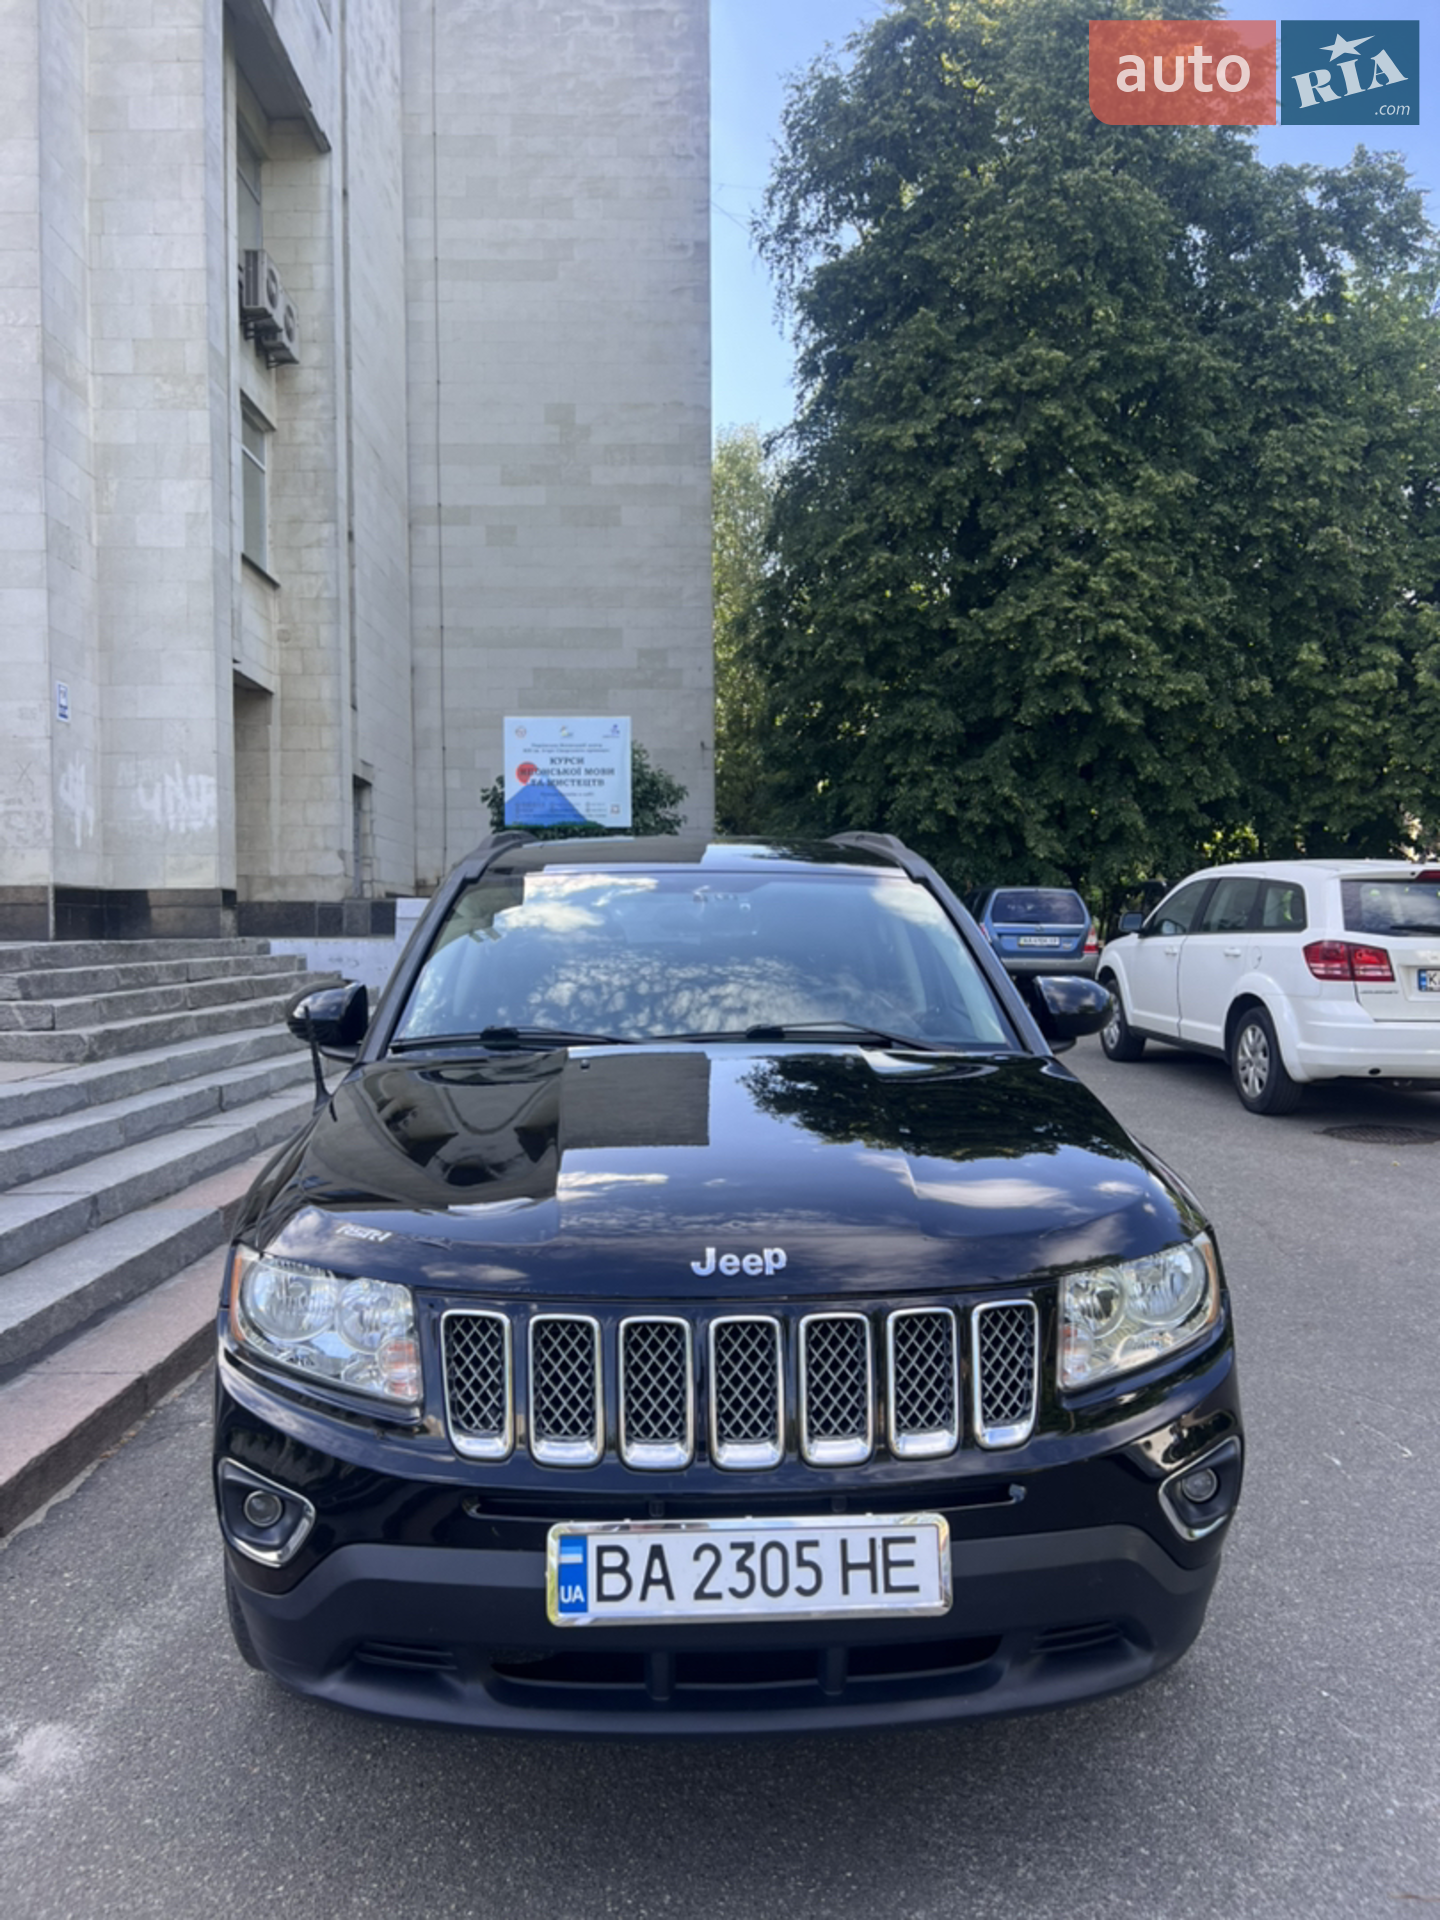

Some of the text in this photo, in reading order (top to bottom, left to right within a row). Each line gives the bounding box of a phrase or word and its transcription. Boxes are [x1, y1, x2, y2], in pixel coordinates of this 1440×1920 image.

[549, 757, 585, 765] КУРСИ
[690, 1247, 787, 1276] Jeep
[595, 1535, 920, 1602] BA 2305 HE
[560, 1585, 585, 1604] UA
